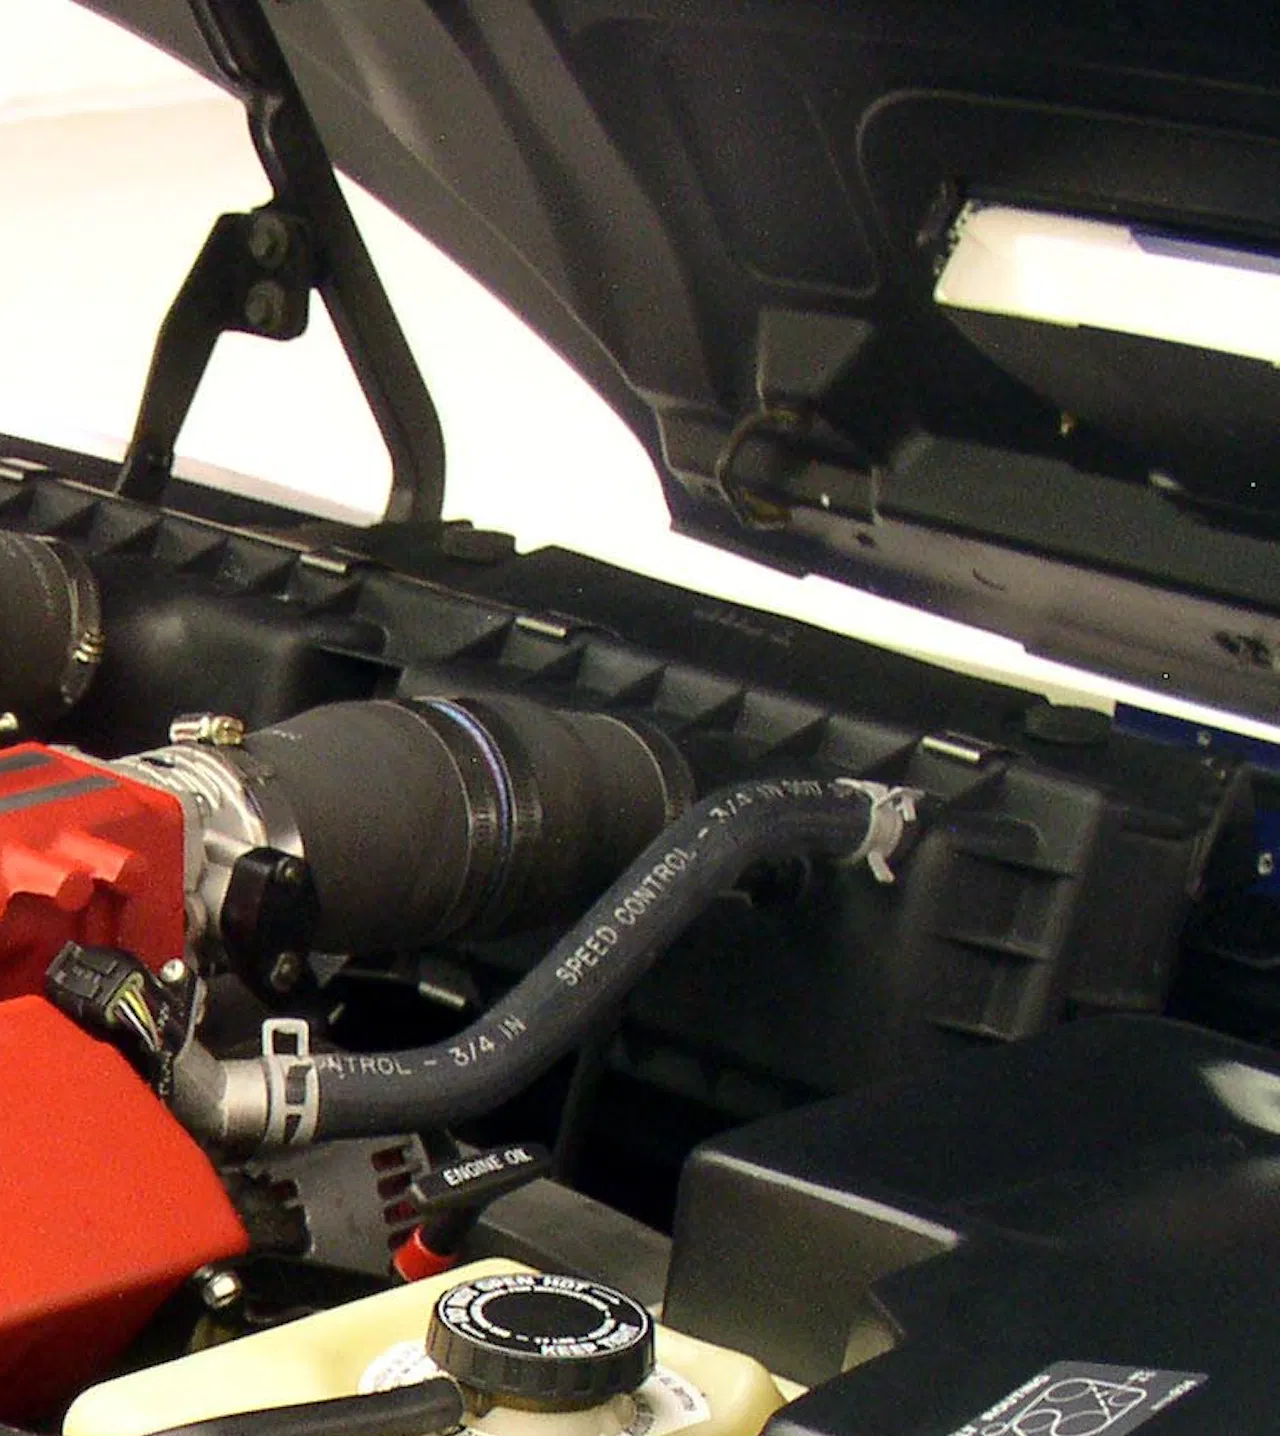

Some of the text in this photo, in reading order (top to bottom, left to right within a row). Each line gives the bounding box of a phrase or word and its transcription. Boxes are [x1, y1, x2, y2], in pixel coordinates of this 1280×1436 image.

[555, 924, 619, 987] SPEED
[614, 845, 697, 928] CONTROL
[448, 1035, 495, 1067] 3/4
[497, 1013, 528, 1042] IN
[442, 1147, 534, 1187] ENGINE OIL
[474, 1274, 535, 1291] OPEN
[542, 1275, 591, 1292] HOT
